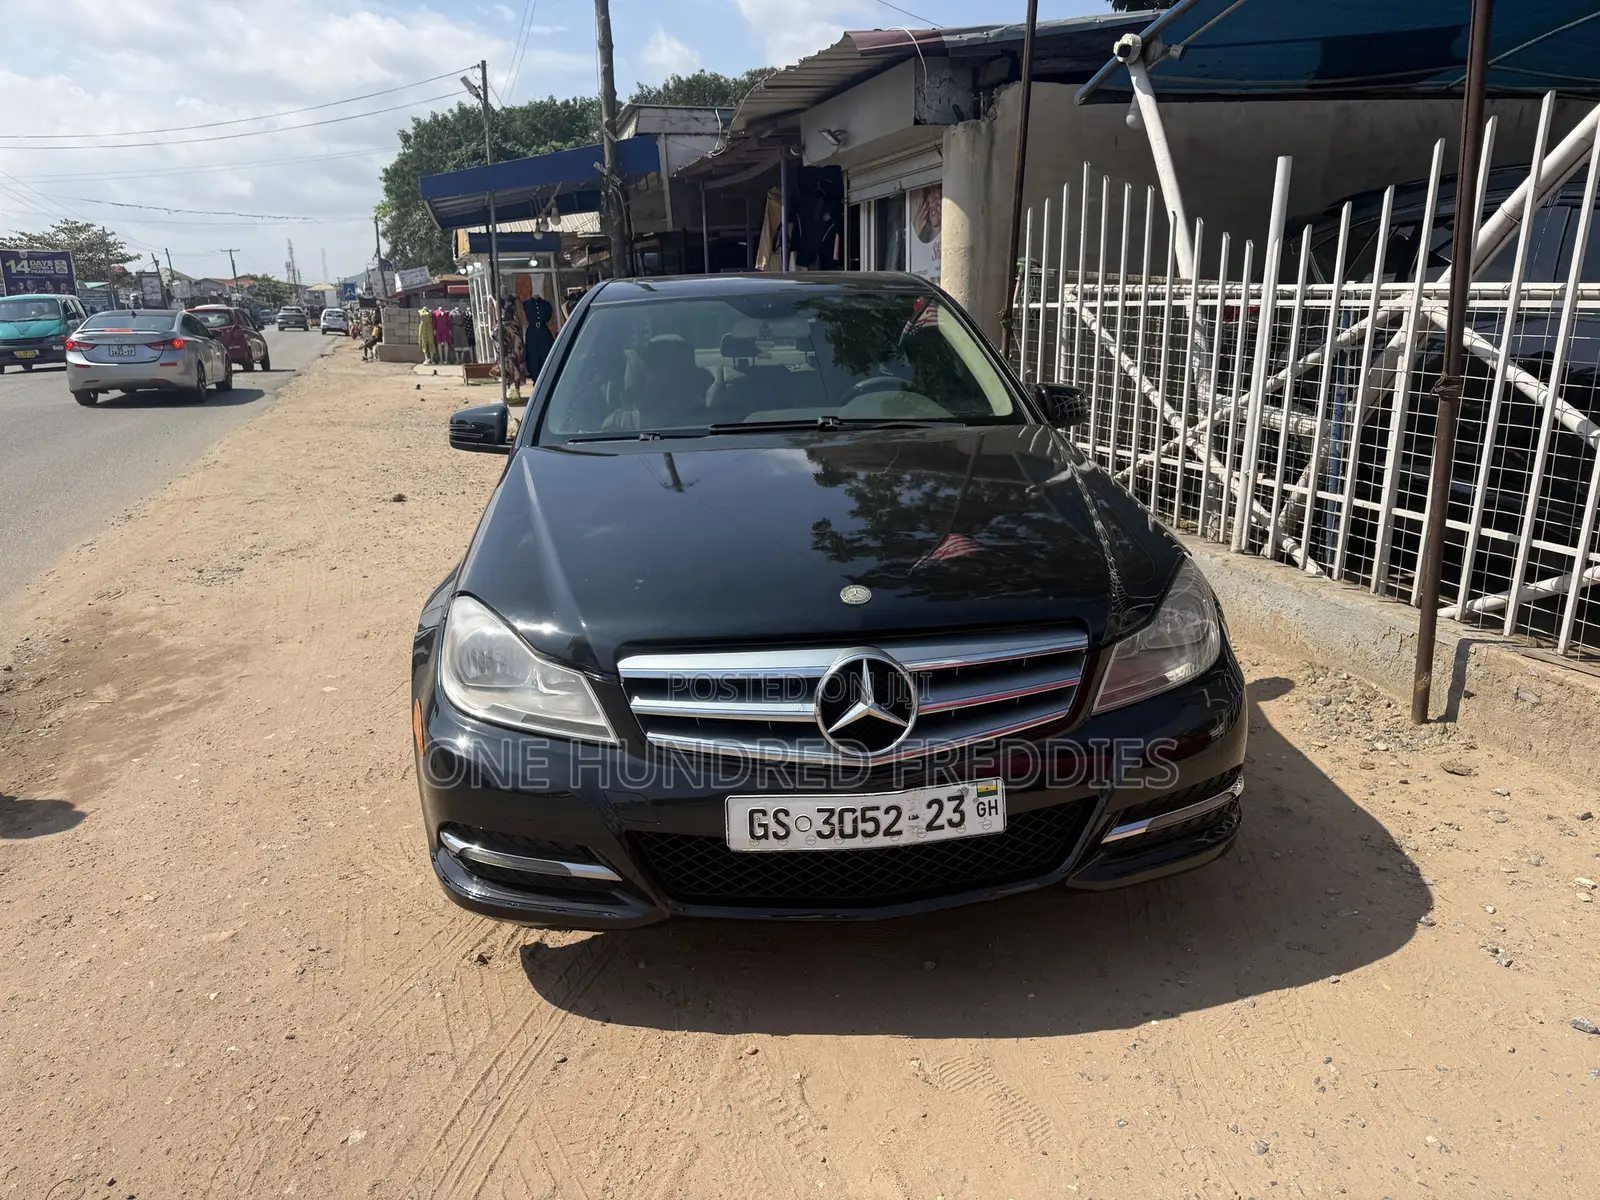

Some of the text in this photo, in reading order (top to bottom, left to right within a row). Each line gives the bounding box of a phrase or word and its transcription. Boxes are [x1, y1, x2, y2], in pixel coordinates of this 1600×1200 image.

[6, 260, 30, 274] 14
[976, 799, 999, 818] GH
[748, 806, 791, 841] GS
